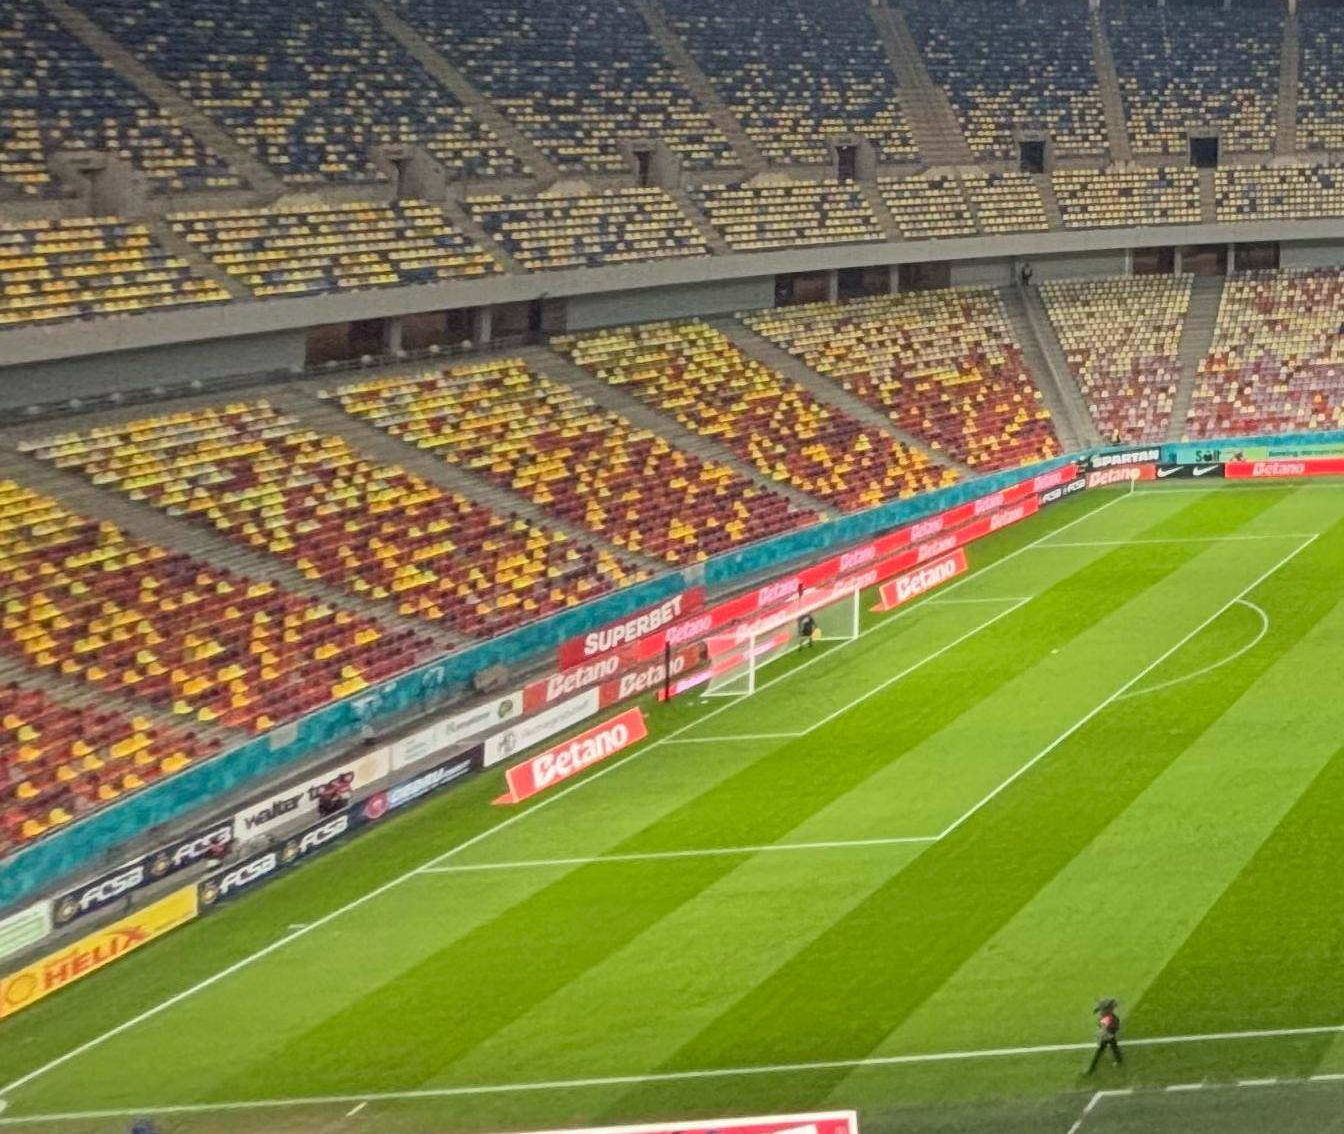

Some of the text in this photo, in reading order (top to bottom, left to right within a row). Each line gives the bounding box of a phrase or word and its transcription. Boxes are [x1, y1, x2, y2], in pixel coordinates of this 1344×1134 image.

[1092, 449, 1160, 468] SPARTAN
[1252, 462, 1305, 477] Betano
[896, 558, 956, 603] Betano
[584, 594, 683, 656] SUPERBET
[545, 655, 620, 702] Betano
[619, 654, 685, 700] Betano
[531, 722, 629, 790] Betano
[243, 793, 300, 831] walter
[299, 814, 349, 853] FCSB
[80, 866, 145, 910] FCSB
[219, 852, 277, 895] FCSB
[42, 926, 150, 991] HELIX
